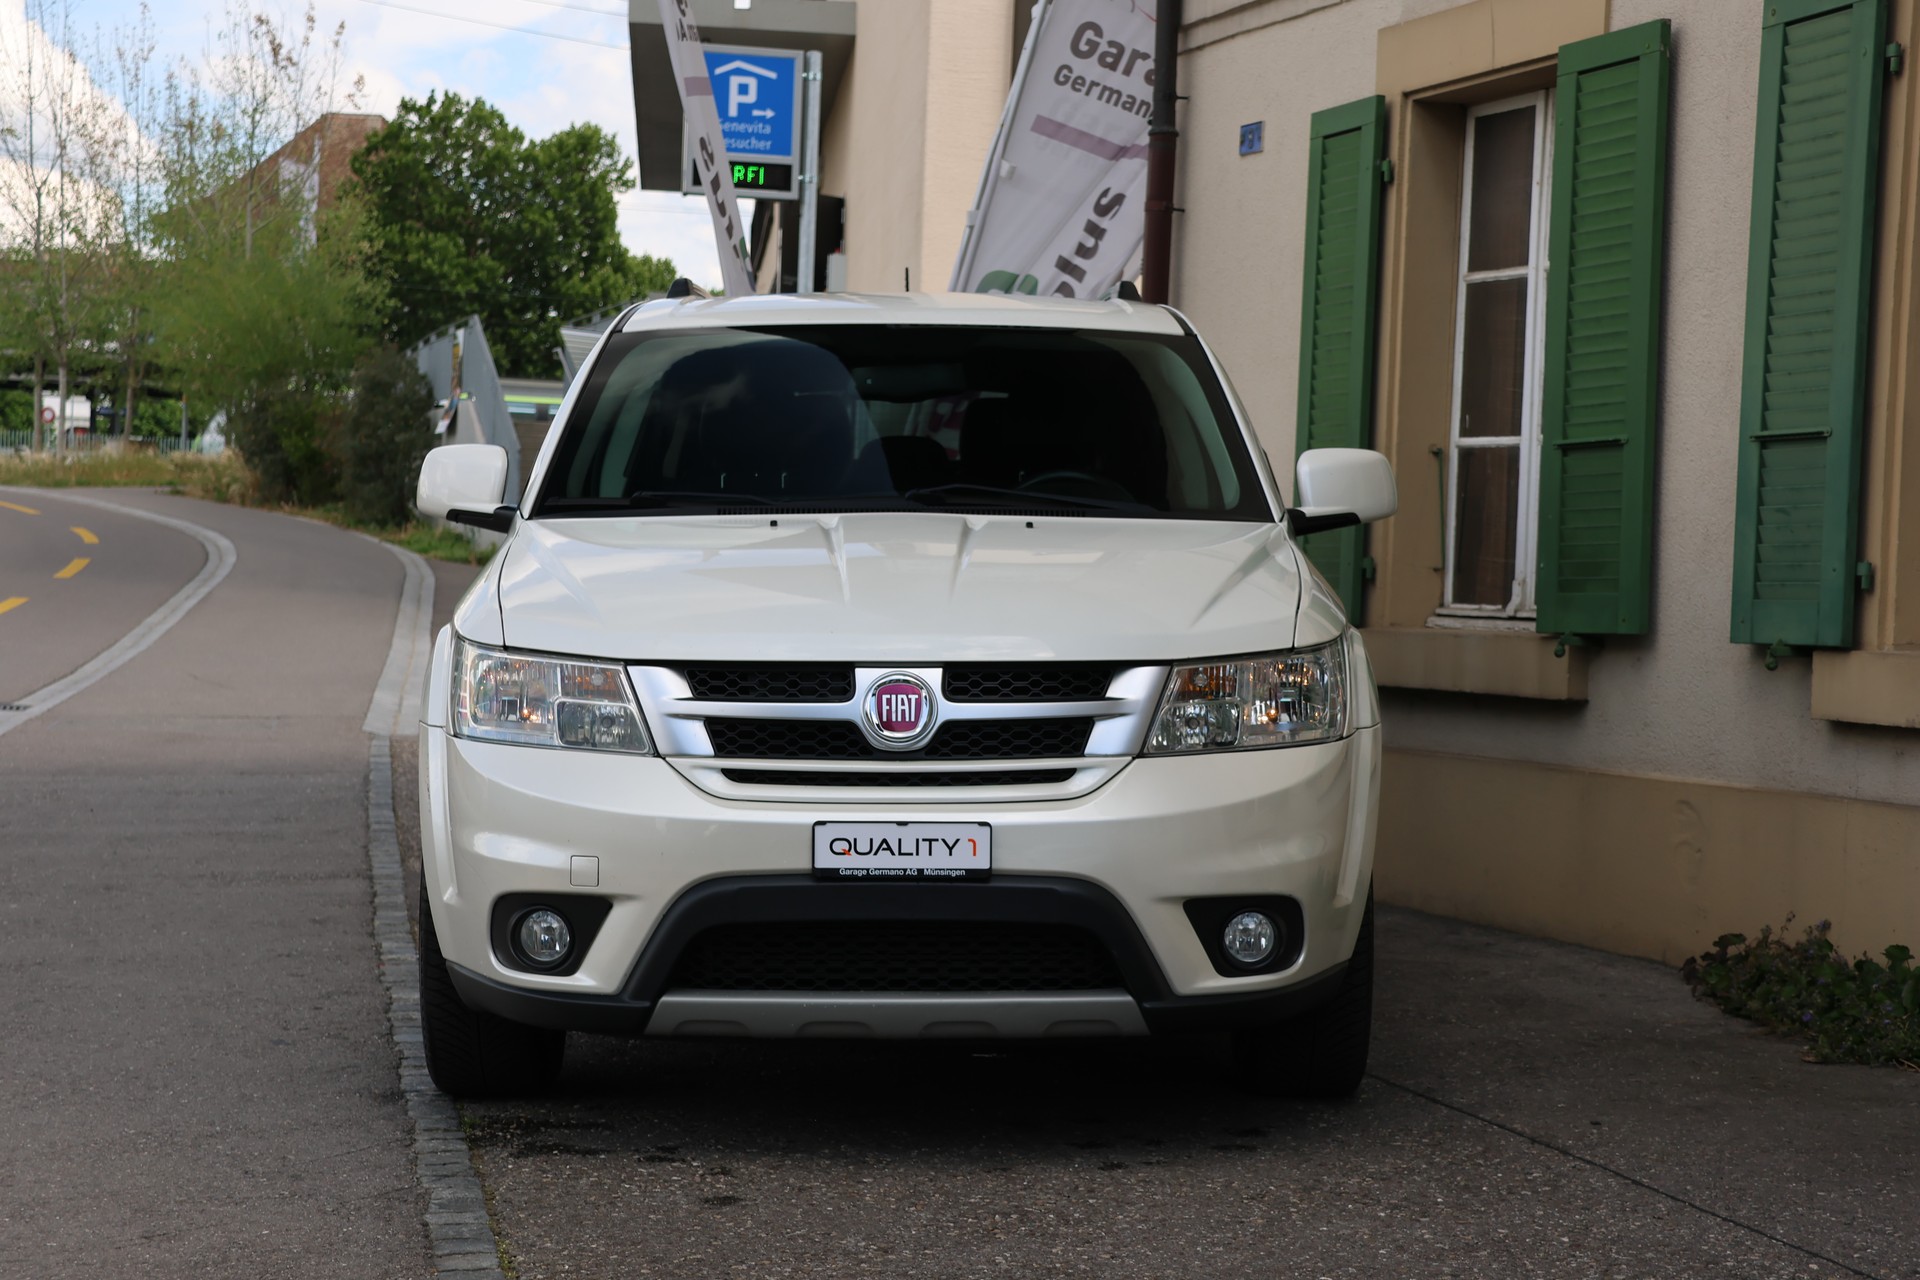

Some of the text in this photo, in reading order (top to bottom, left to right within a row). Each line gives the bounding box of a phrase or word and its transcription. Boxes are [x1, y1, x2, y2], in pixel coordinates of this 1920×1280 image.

[728, 75, 758, 117] P
[1053, 64, 1153, 118] German
[719, 118, 772, 134] enevita
[724, 136, 772, 150] esucher
[881, 694, 918, 722] FIAT
[829, 837, 977, 857] QUALITY 1
[839, 867, 966, 877] Garage Germano AG Münsingen
